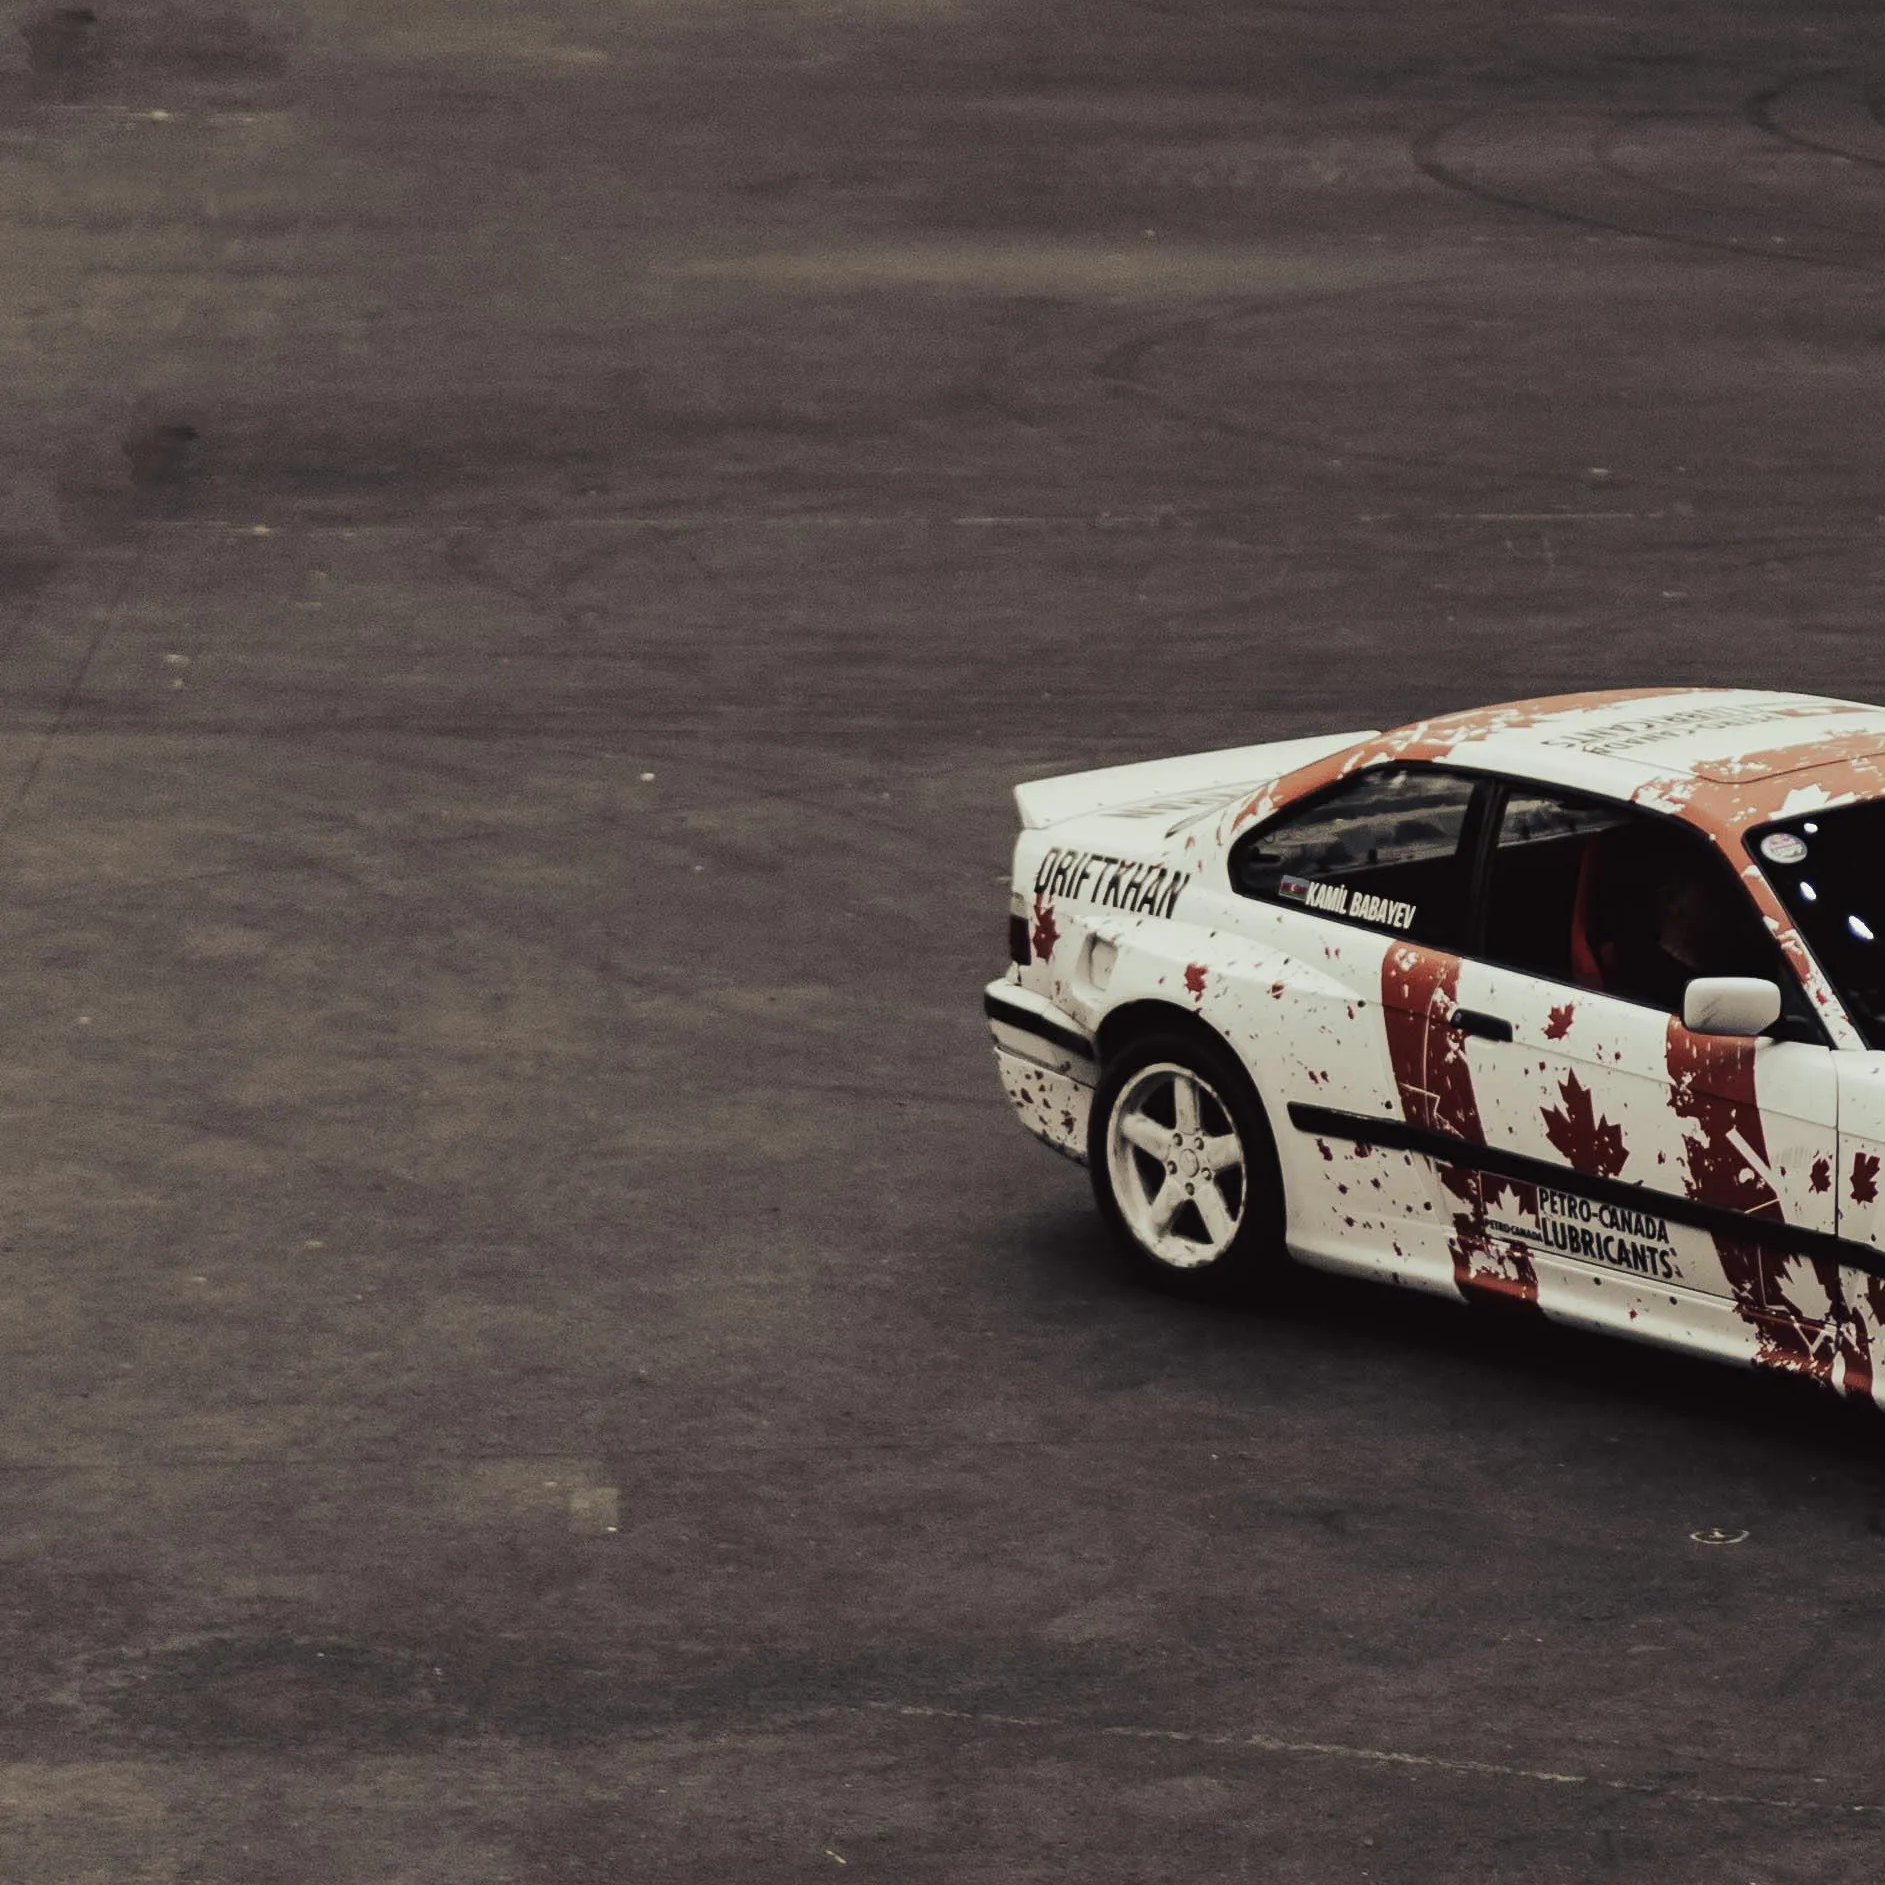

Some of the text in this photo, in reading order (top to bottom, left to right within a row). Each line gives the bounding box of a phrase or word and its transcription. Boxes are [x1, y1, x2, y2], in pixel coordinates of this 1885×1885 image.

[1034, 846, 1191, 919] DRIFTKHAN
[1349, 891, 1417, 930] BABAYEV
[1538, 1186, 1670, 1245] PETRO-CANADA
[1541, 1218, 1675, 1279] LUBRICANTS
